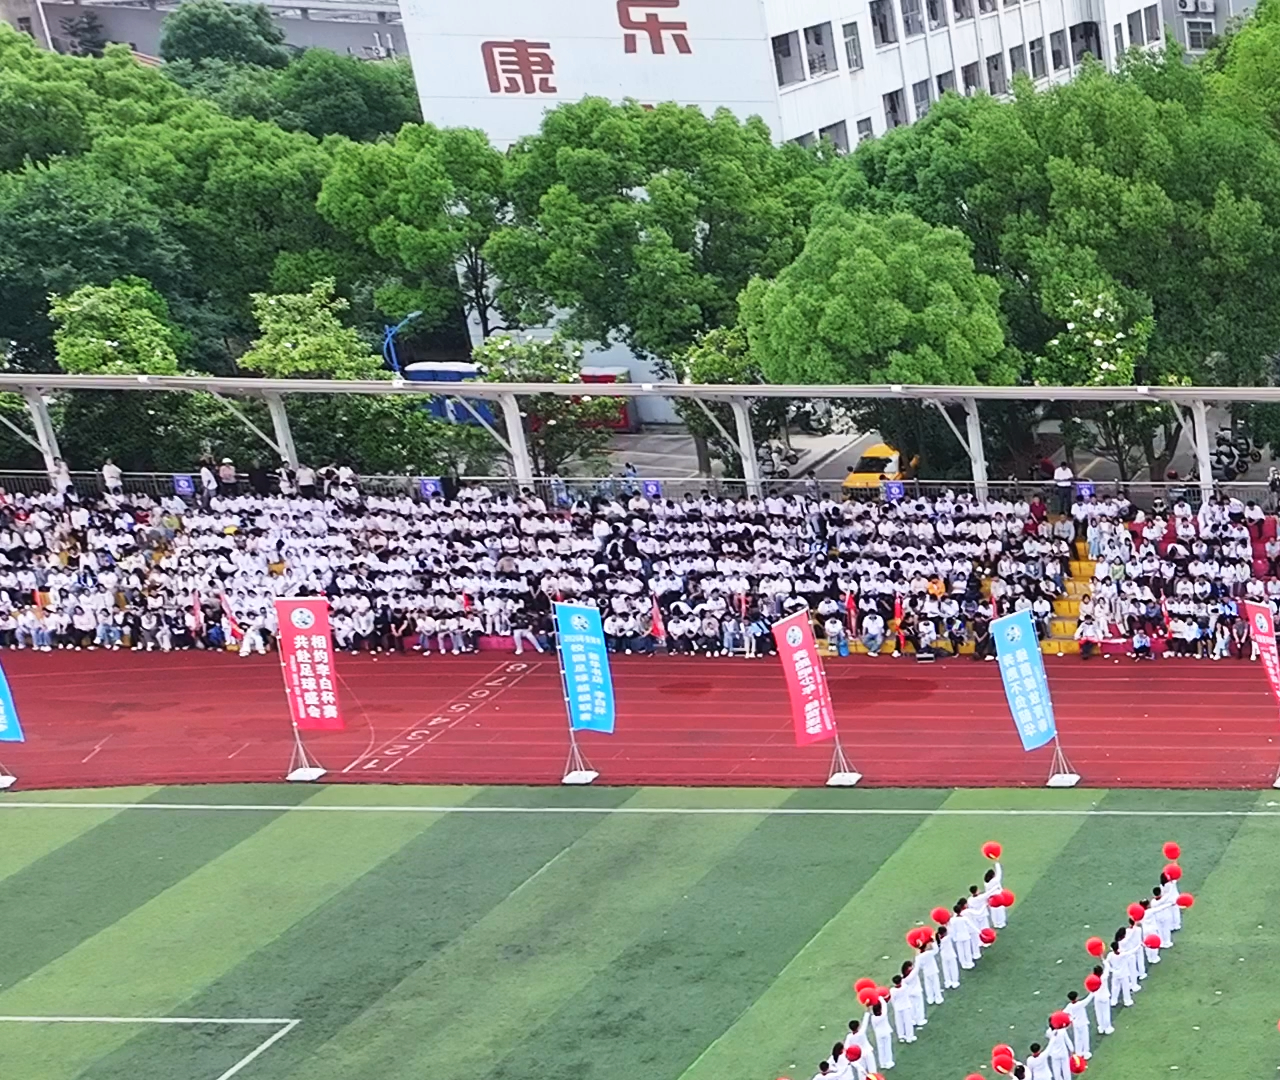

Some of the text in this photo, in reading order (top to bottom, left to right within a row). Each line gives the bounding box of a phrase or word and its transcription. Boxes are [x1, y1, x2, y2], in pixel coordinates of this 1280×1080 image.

[616, 0, 692, 54] 乐
[481, 39, 557, 94] 康
[294, 635, 321, 718] 共赴足球盛会
[311, 635, 338, 718] 相约李白杯赛
[484, 676, 507, 686] 7
